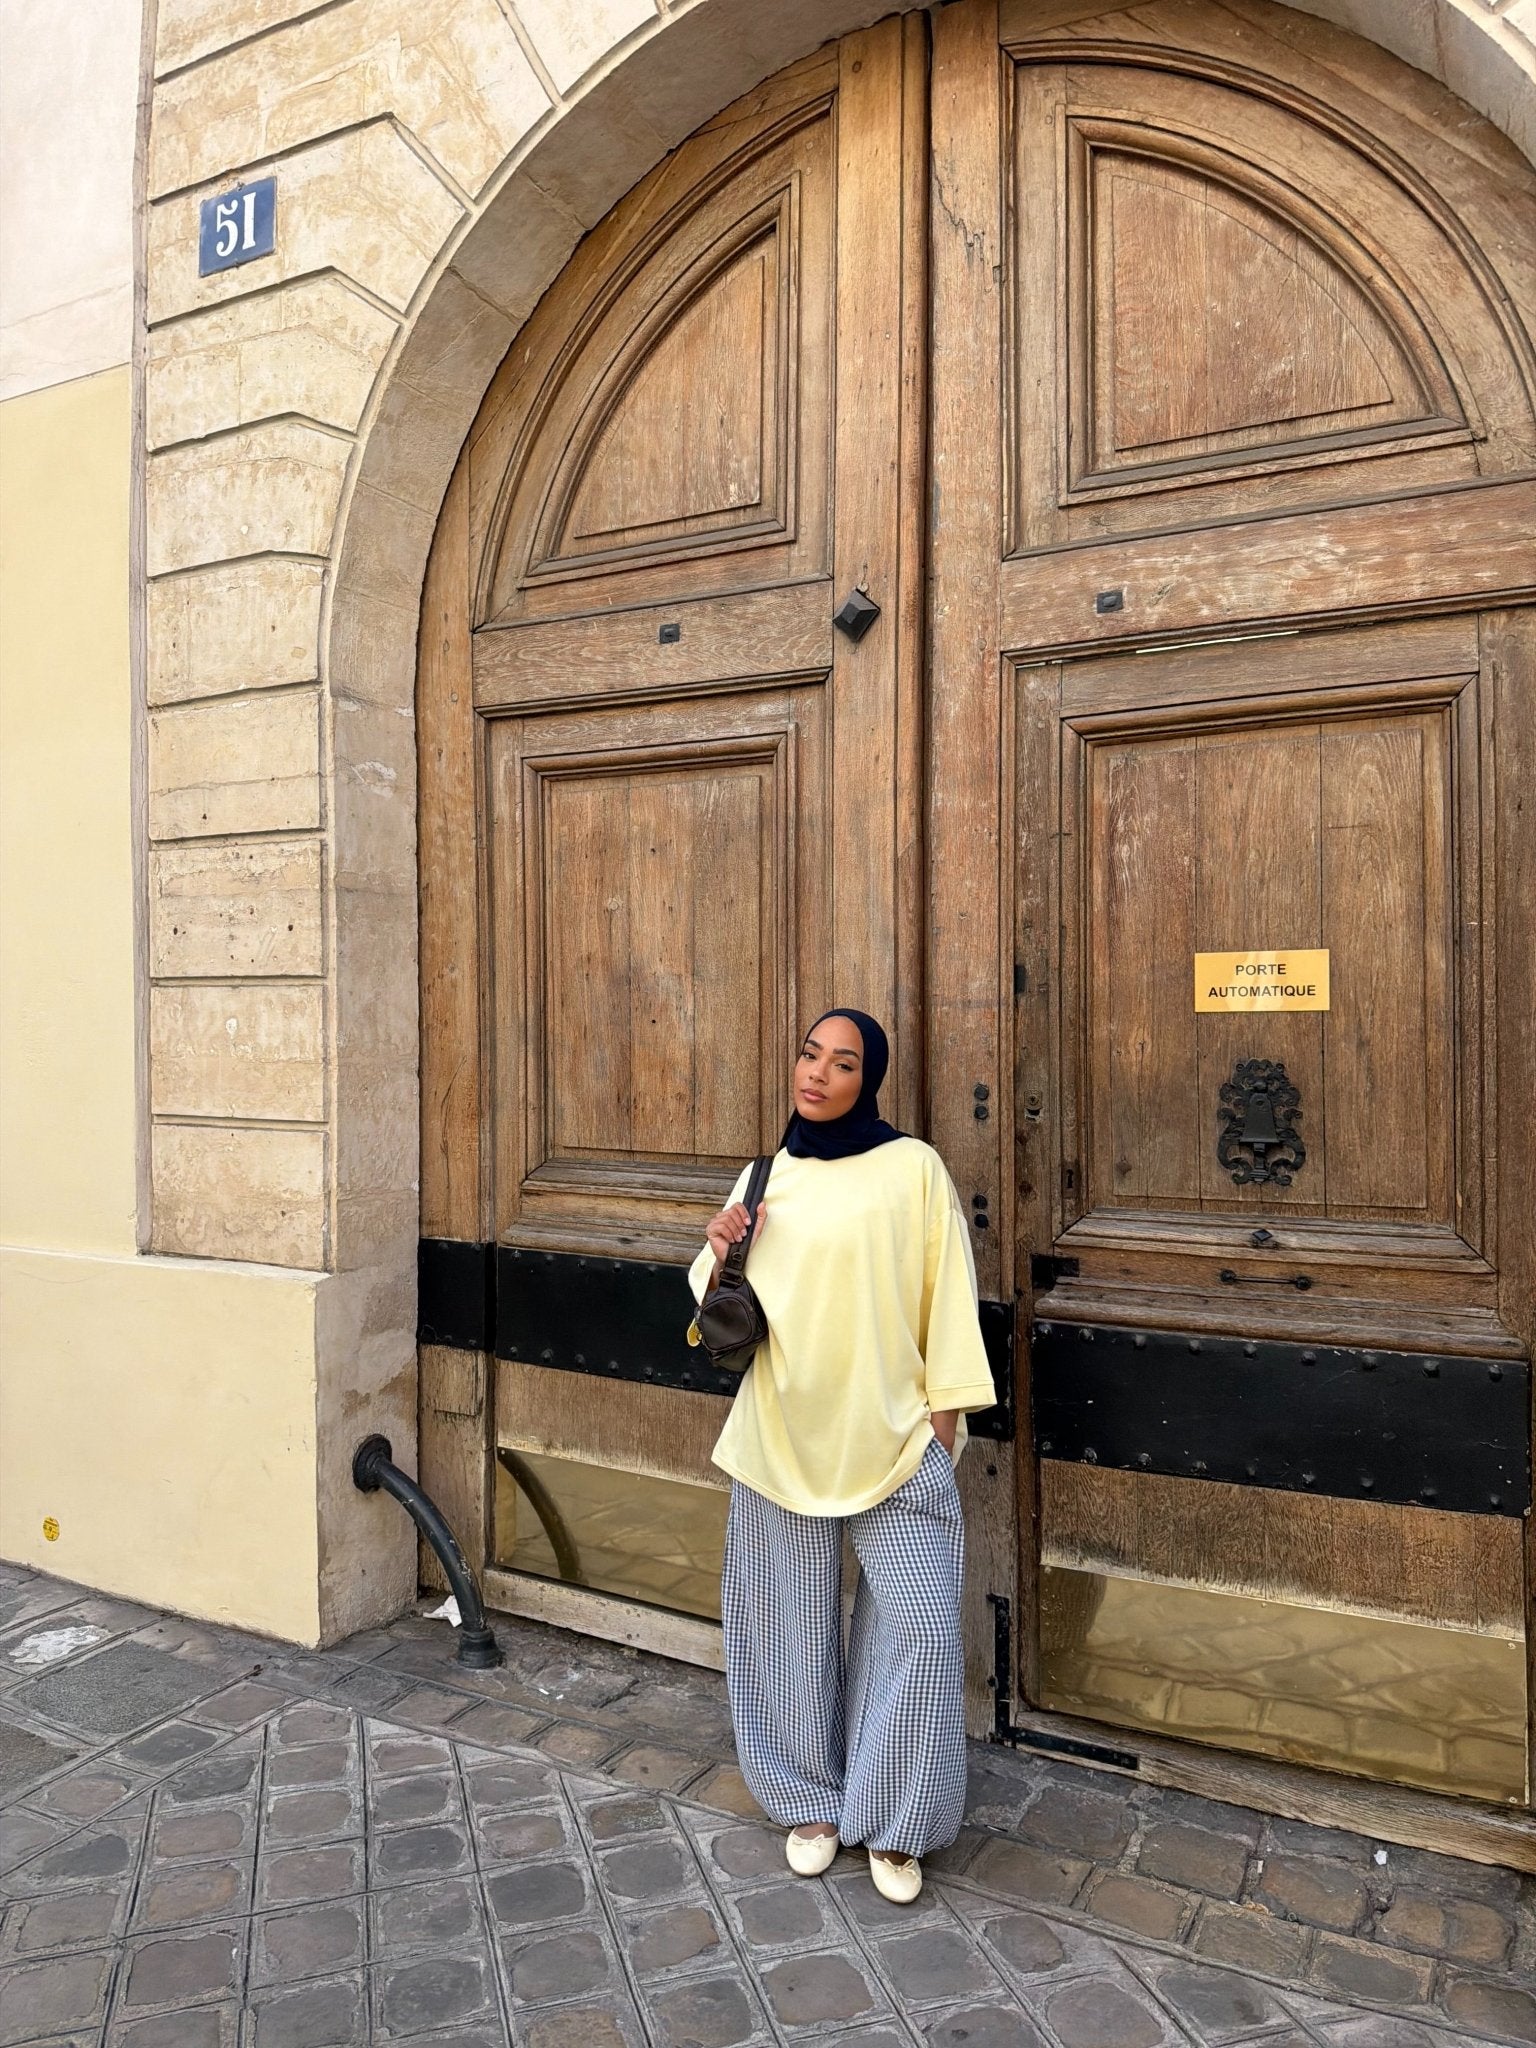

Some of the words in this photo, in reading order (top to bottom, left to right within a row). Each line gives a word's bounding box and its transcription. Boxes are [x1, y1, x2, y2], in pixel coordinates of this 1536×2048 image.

[216, 191, 257, 257] 51
[1235, 963, 1287, 976] PORTE
[1208, 984, 1317, 998] AUTOMATIQUE
